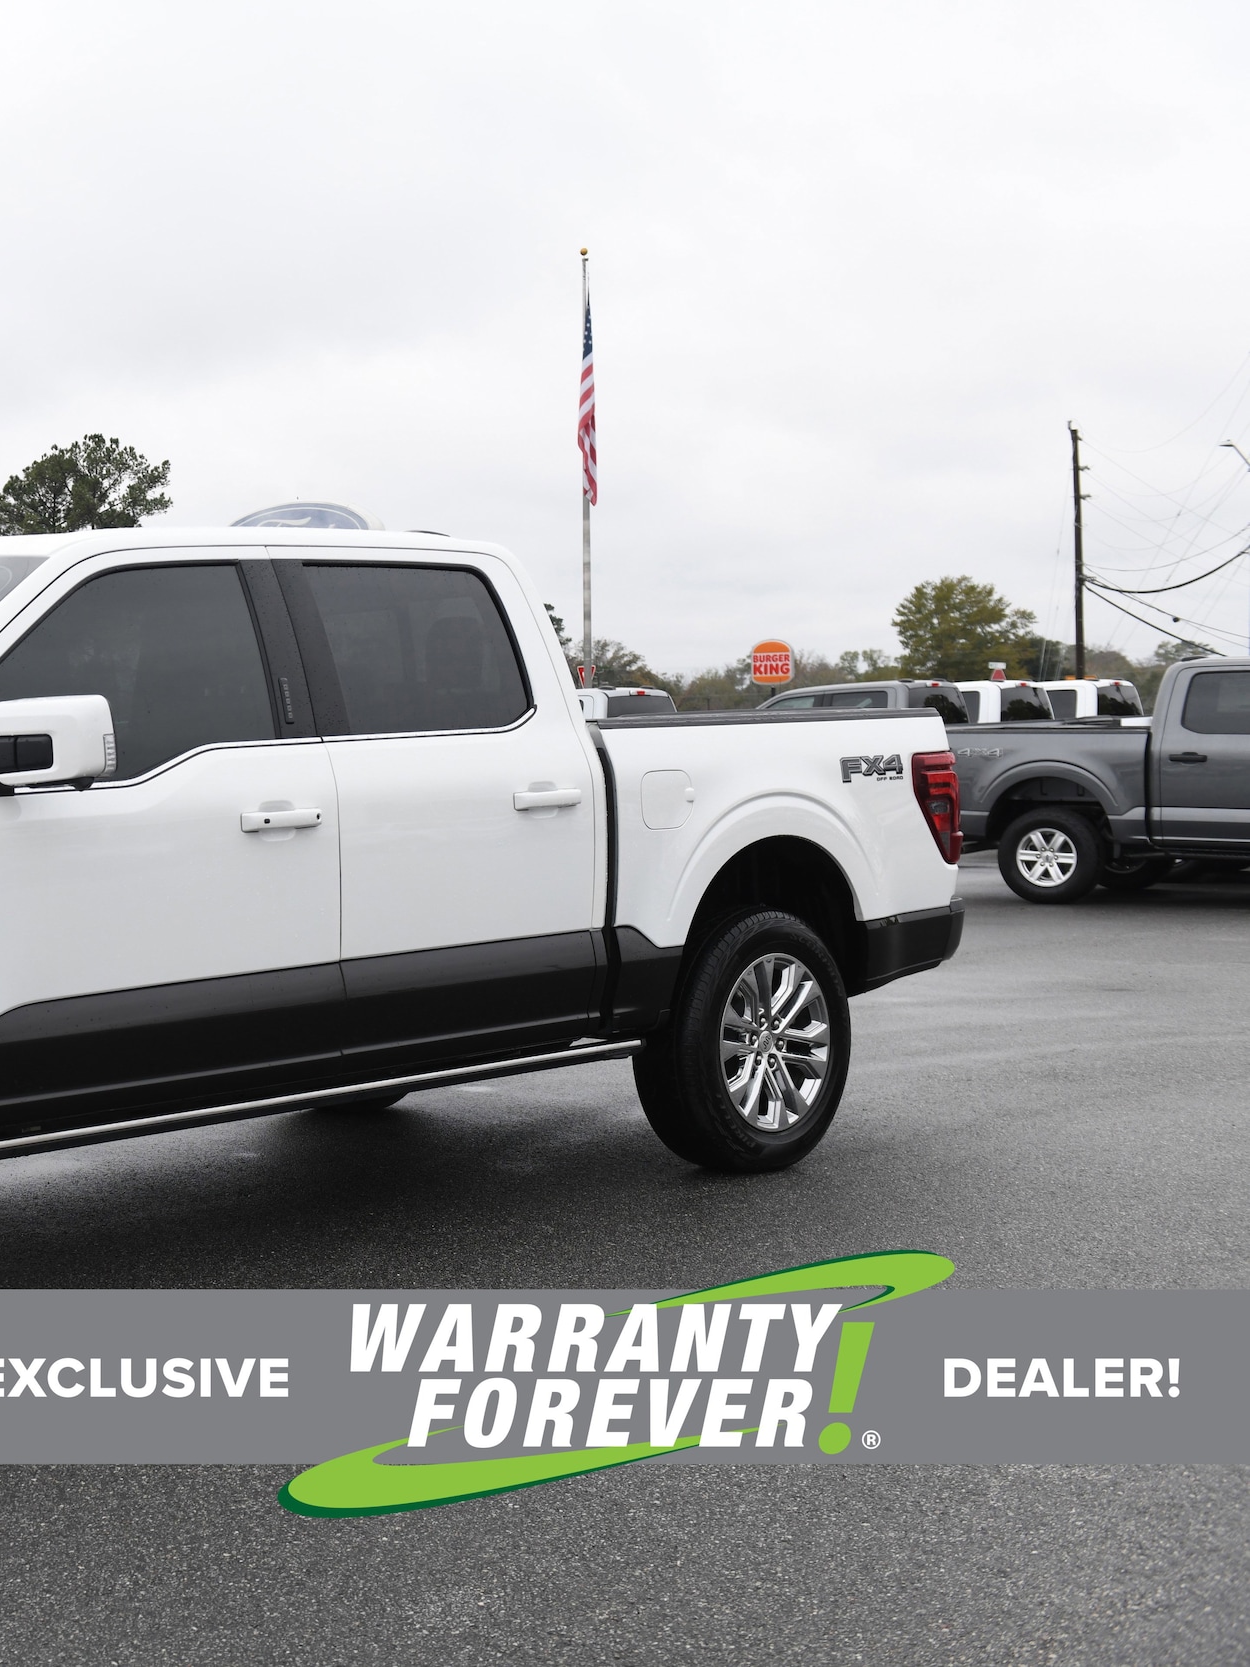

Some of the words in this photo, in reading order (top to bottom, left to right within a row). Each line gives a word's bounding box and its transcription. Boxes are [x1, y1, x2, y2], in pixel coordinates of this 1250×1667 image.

[753, 653, 790, 663] BURGER
[753, 663, 791, 675] KING
[840, 754, 903, 783] FX4
